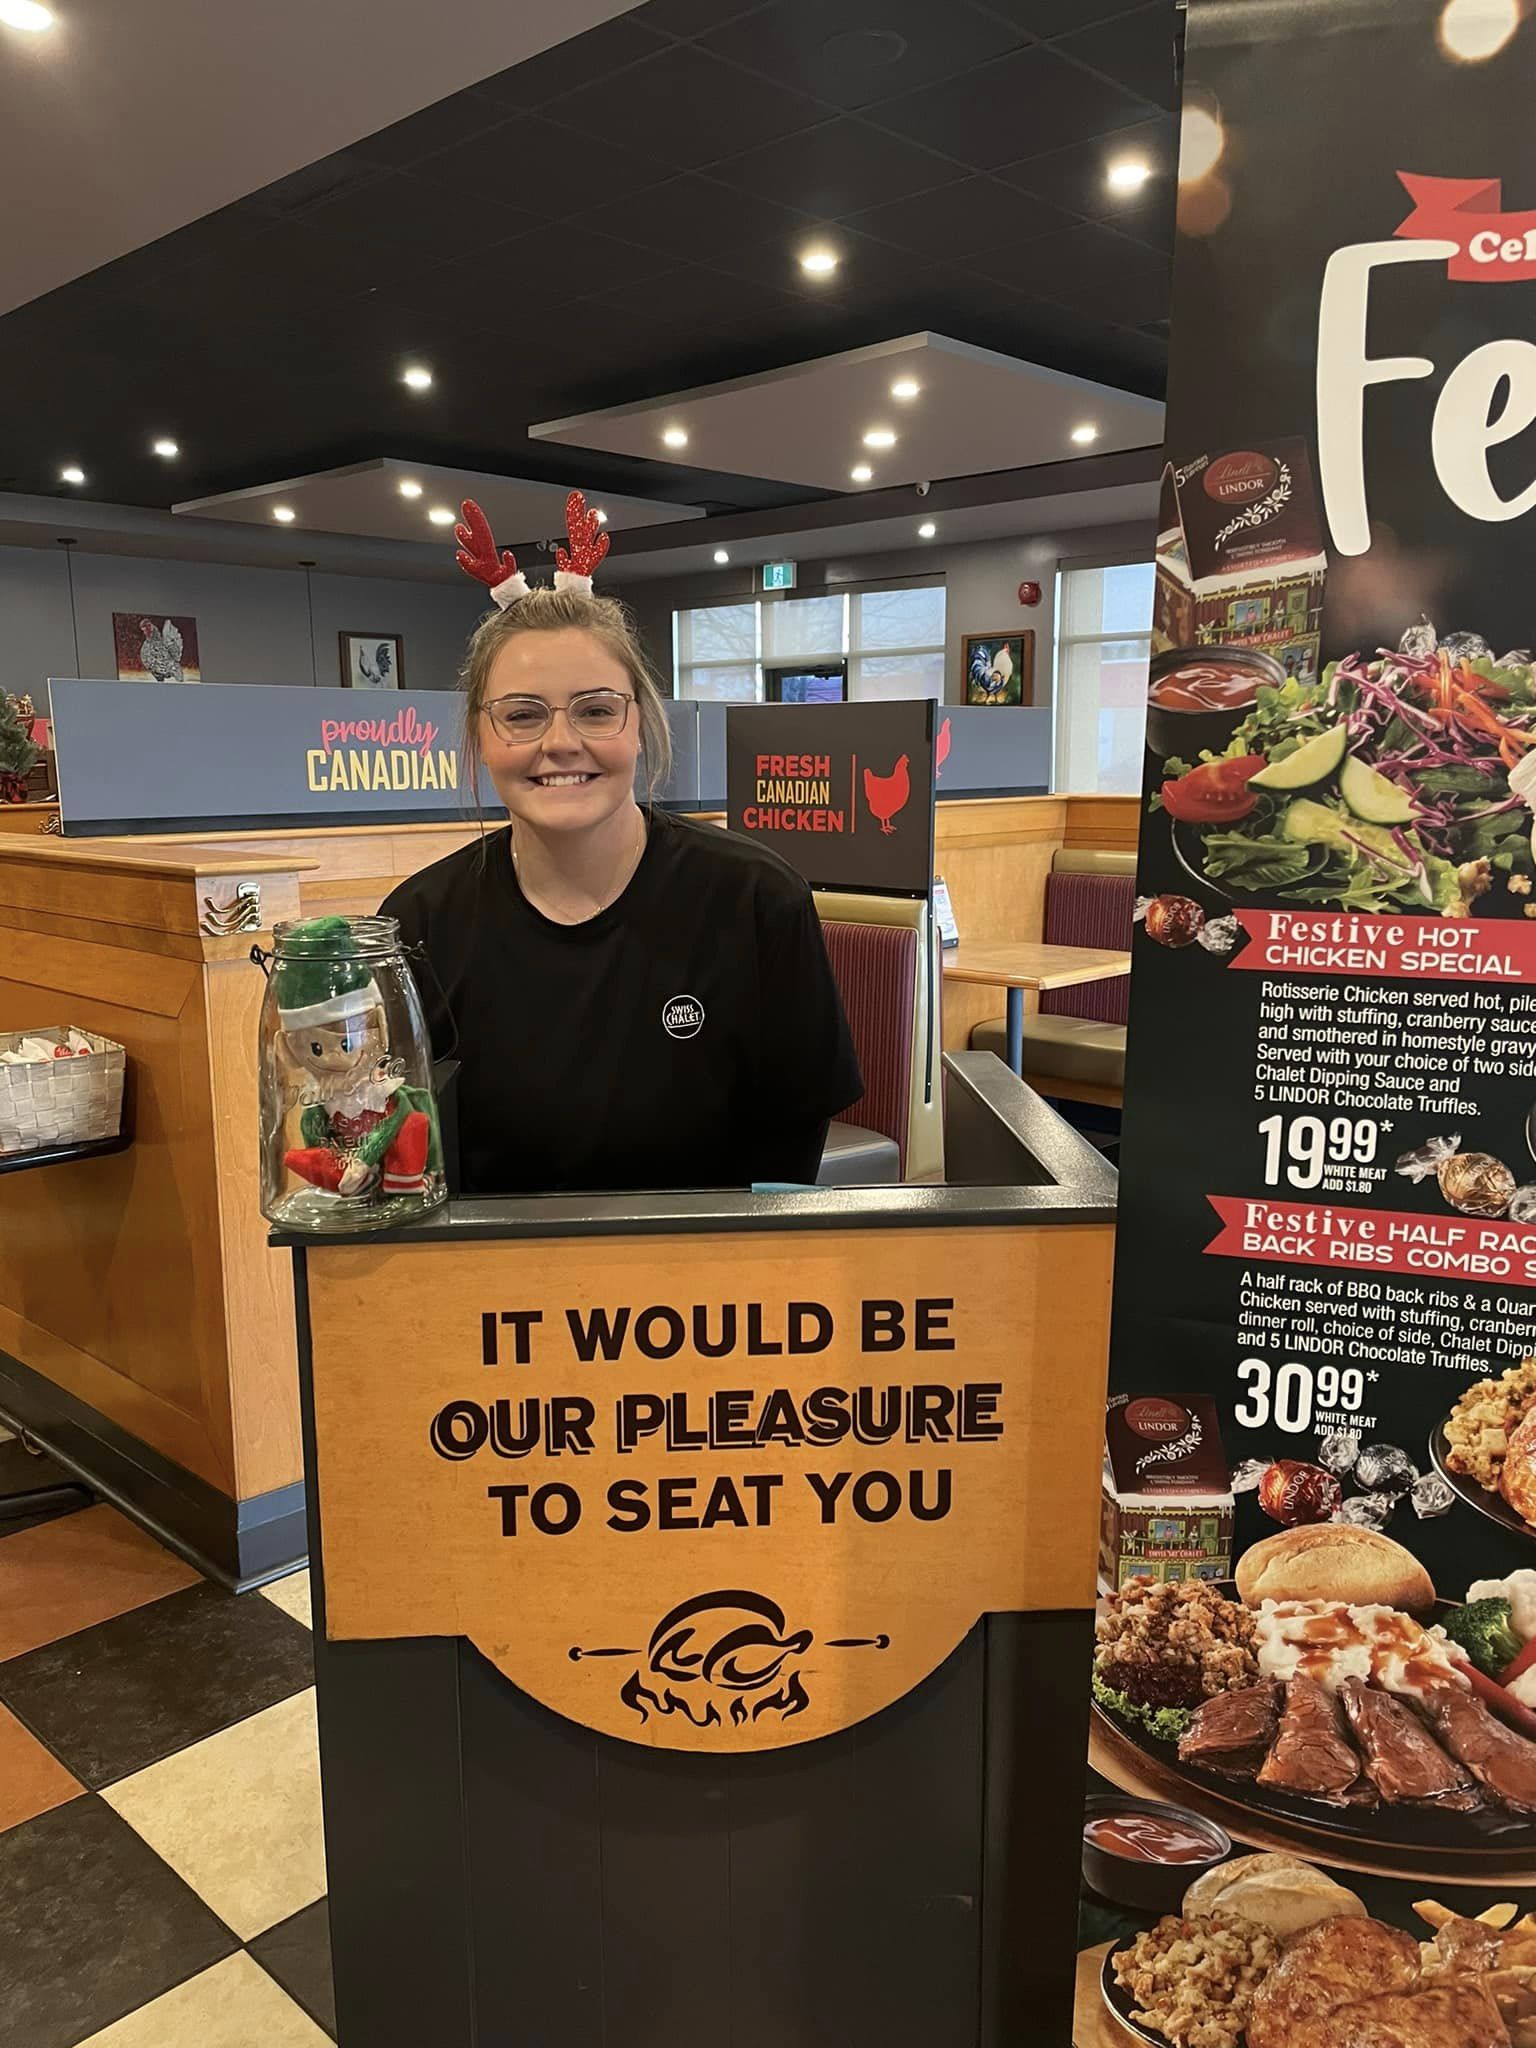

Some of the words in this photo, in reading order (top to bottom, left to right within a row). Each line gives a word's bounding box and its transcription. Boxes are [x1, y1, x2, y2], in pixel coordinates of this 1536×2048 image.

[1317, 239, 1536, 556] Fe
[1219, 479, 1264, 496] LINDOR
[321, 706, 439, 756] proudly
[307, 749, 457, 792] CANADIAN
[756, 754, 831, 778] FRESH
[757, 779, 830, 805] CANADIAN
[743, 808, 844, 833] CHICKEN
[1266, 913, 1404, 946] Festive
[1417, 926, 1479, 948] HOT
[1266, 945, 1386, 969] CHICKEN
[1400, 951, 1522, 976] SPECIAL
[671, 1004, 694, 1014] SWISS
[1261, 981, 1340, 1002] Rotisserie
[1343, 985, 1409, 1005] Chicken
[1412, 991, 1470, 1008] served
[1473, 991, 1505, 1013] hot,
[666, 1011, 700, 1025] CHALET
[1260, 1002, 1294, 1023] high
[1298, 1004, 1333, 1022] with
[1336, 1007, 1402, 1030] stuffing,
[1406, 1012, 1487, 1034] cranberry
[1258, 1023, 1289, 1040] and
[1292, 1026, 1378, 1046] smothered
[1381, 1030, 1397, 1047] in
[1402, 1032, 1485, 1055] homestyle
[1490, 1039, 1536, 1059] gravy
[1256, 1042, 1312, 1063] Served
[1315, 1047, 1351, 1065] with
[1354, 1052, 1392, 1069] your
[1394, 1052, 1449, 1071] choice
[1452, 1055, 1471, 1073] of
[1473, 1057, 1505, 1075] two
[1508, 1059, 1536, 1077] sid
[1255, 1063, 1306, 1083] Chalet
[1309, 1067, 1370, 1091] Dipping
[1374, 1071, 1425, 1091] Sauce
[1428, 1076, 1461, 1093] and
[1254, 1084, 1265, 1101] 5
[1269, 1085, 1330, 1105] LINDOR
[1334, 1089, 1414, 1111] Chocolate
[1417, 1095, 1481, 1116] Truffles.
[1321, 1177, 1344, 1191] ADD
[1345, 1179, 1372, 1194] $1.80
[1323, 1164, 1357, 1179] WHITE
[1358, 1166, 1388, 1181] MEAT
[1244, 1203, 1375, 1239] Festive
[1389, 1222, 1466, 1246] HALF
[1243, 1232, 1315, 1257] BACK
[1329, 1240, 1393, 1264] RIBS
[1407, 1248, 1511, 1275] COMBO
[1240, 1271, 1253, 1287] A
[1256, 1272, 1286, 1290] half
[1290, 1276, 1322, 1295] rack
[1327, 1280, 1344, 1296] of
[1347, 1281, 1381, 1301] BBQ
[1385, 1285, 1425, 1305] back
[1428, 1290, 1459, 1309] ribs
[1463, 1294, 1477, 1311] &
[1480, 1298, 1491, 1312] a
[1240, 1290, 1301, 1315] Chicken
[1304, 1300, 1358, 1318] served
[1362, 1304, 1396, 1322] with
[1399, 1308, 1465, 1332] stuffing,
[482, 1311, 542, 1365] IT
[566, 1303, 833, 1361] WOULD
[862, 1298, 955, 1352] BE
[1238, 1310, 1288, 1329] dinner
[1291, 1316, 1319, 1335] roll,
[1323, 1319, 1374, 1339] choice
[1378, 1325, 1395, 1341] of
[1398, 1327, 1435, 1348] side,
[1440, 1331, 1492, 1353] Chalet
[1237, 1331, 1266, 1347] and
[1269, 1332, 1281, 1349] 5
[1284, 1333, 1344, 1356] LINDOR
[1348, 1340, 1426, 1365] Chocolate
[1429, 1350, 1493, 1373] Truffles.
[430, 1397, 595, 1461] OUR
[616, 1383, 1003, 1453] PLEASURE
[1138, 1422, 1178, 1431] LINDOR
[1313, 1424, 1335, 1437] ADD
[1315, 1410, 1348, 1427] WHITE
[1349, 1414, 1377, 1429] MEAT
[488, 1483, 581, 1536] TO
[607, 1475, 783, 1532] SEAT
[805, 1469, 951, 1523] YOU
[1284, 1469, 1308, 1511] LINDOR
